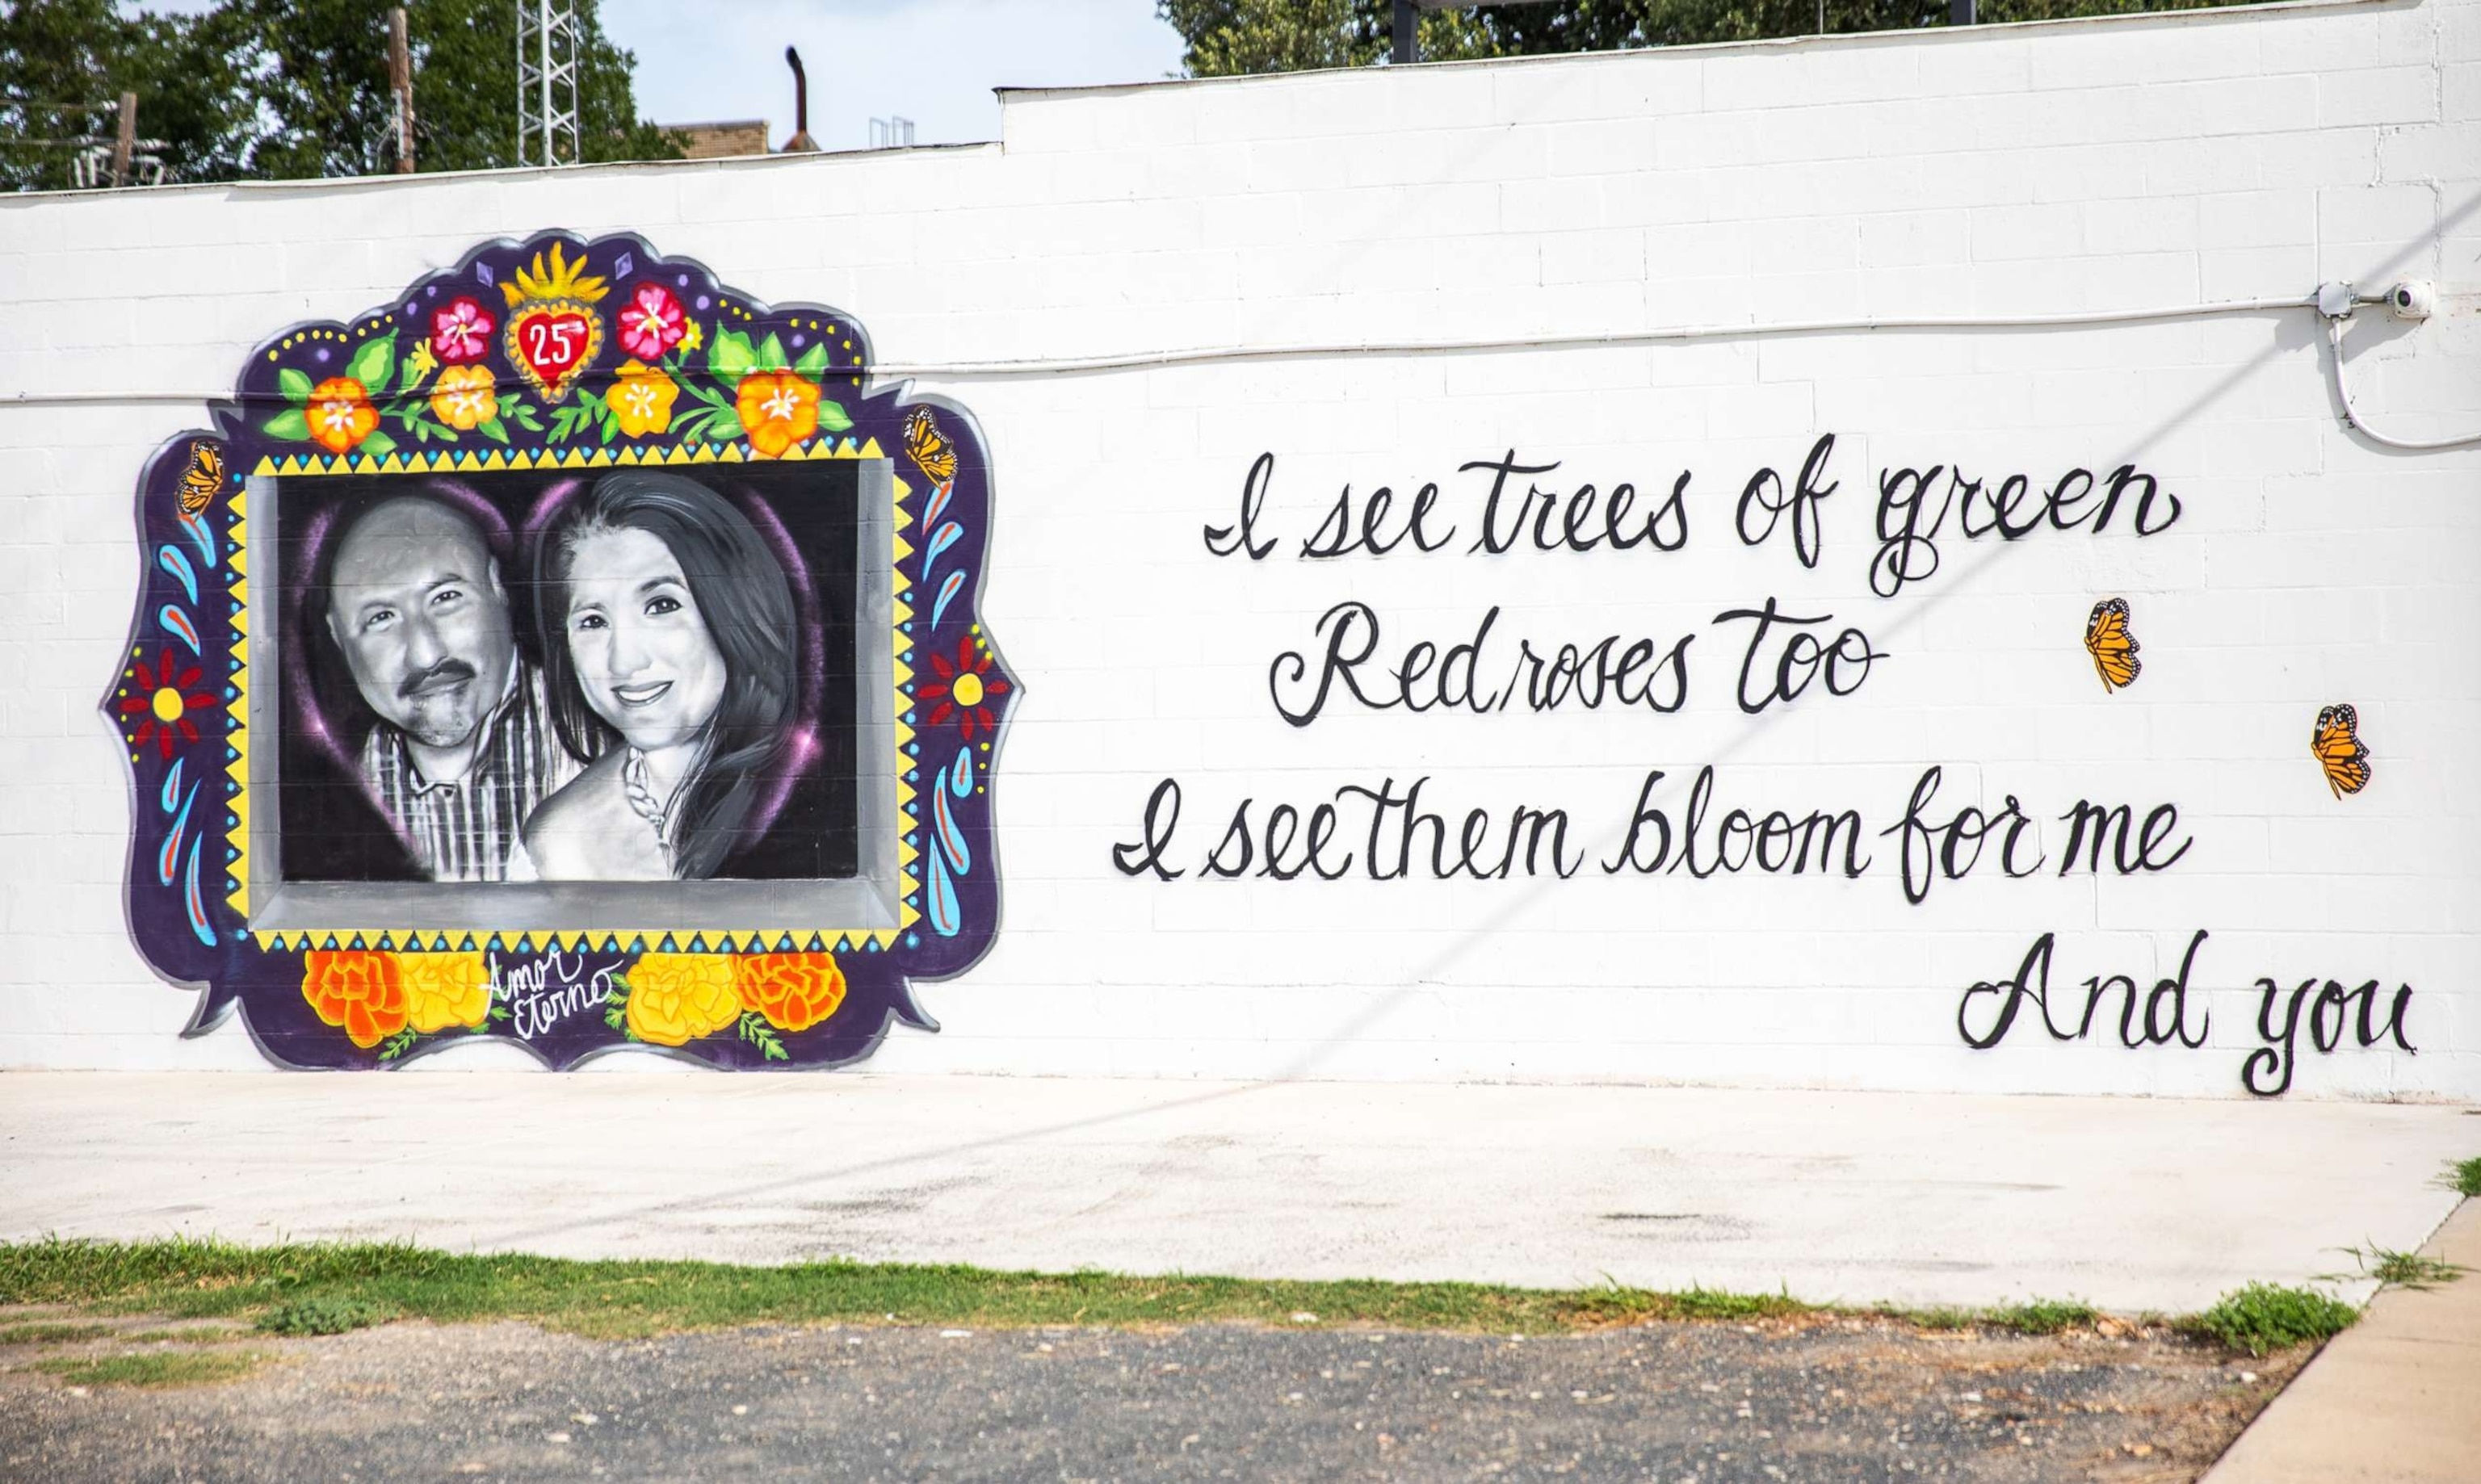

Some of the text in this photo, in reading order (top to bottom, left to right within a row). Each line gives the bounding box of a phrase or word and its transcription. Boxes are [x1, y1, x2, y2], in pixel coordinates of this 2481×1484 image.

[530, 324, 570, 366] 25
[1204, 434, 2181, 598] I see trees of green
[1270, 602, 1501, 727] Red
[1499, 634, 1696, 713] roses
[1113, 765, 2193, 905] I see them bloom for me
[478, 950, 583, 1019] Amor
[1958, 933, 2417, 1097] And you
